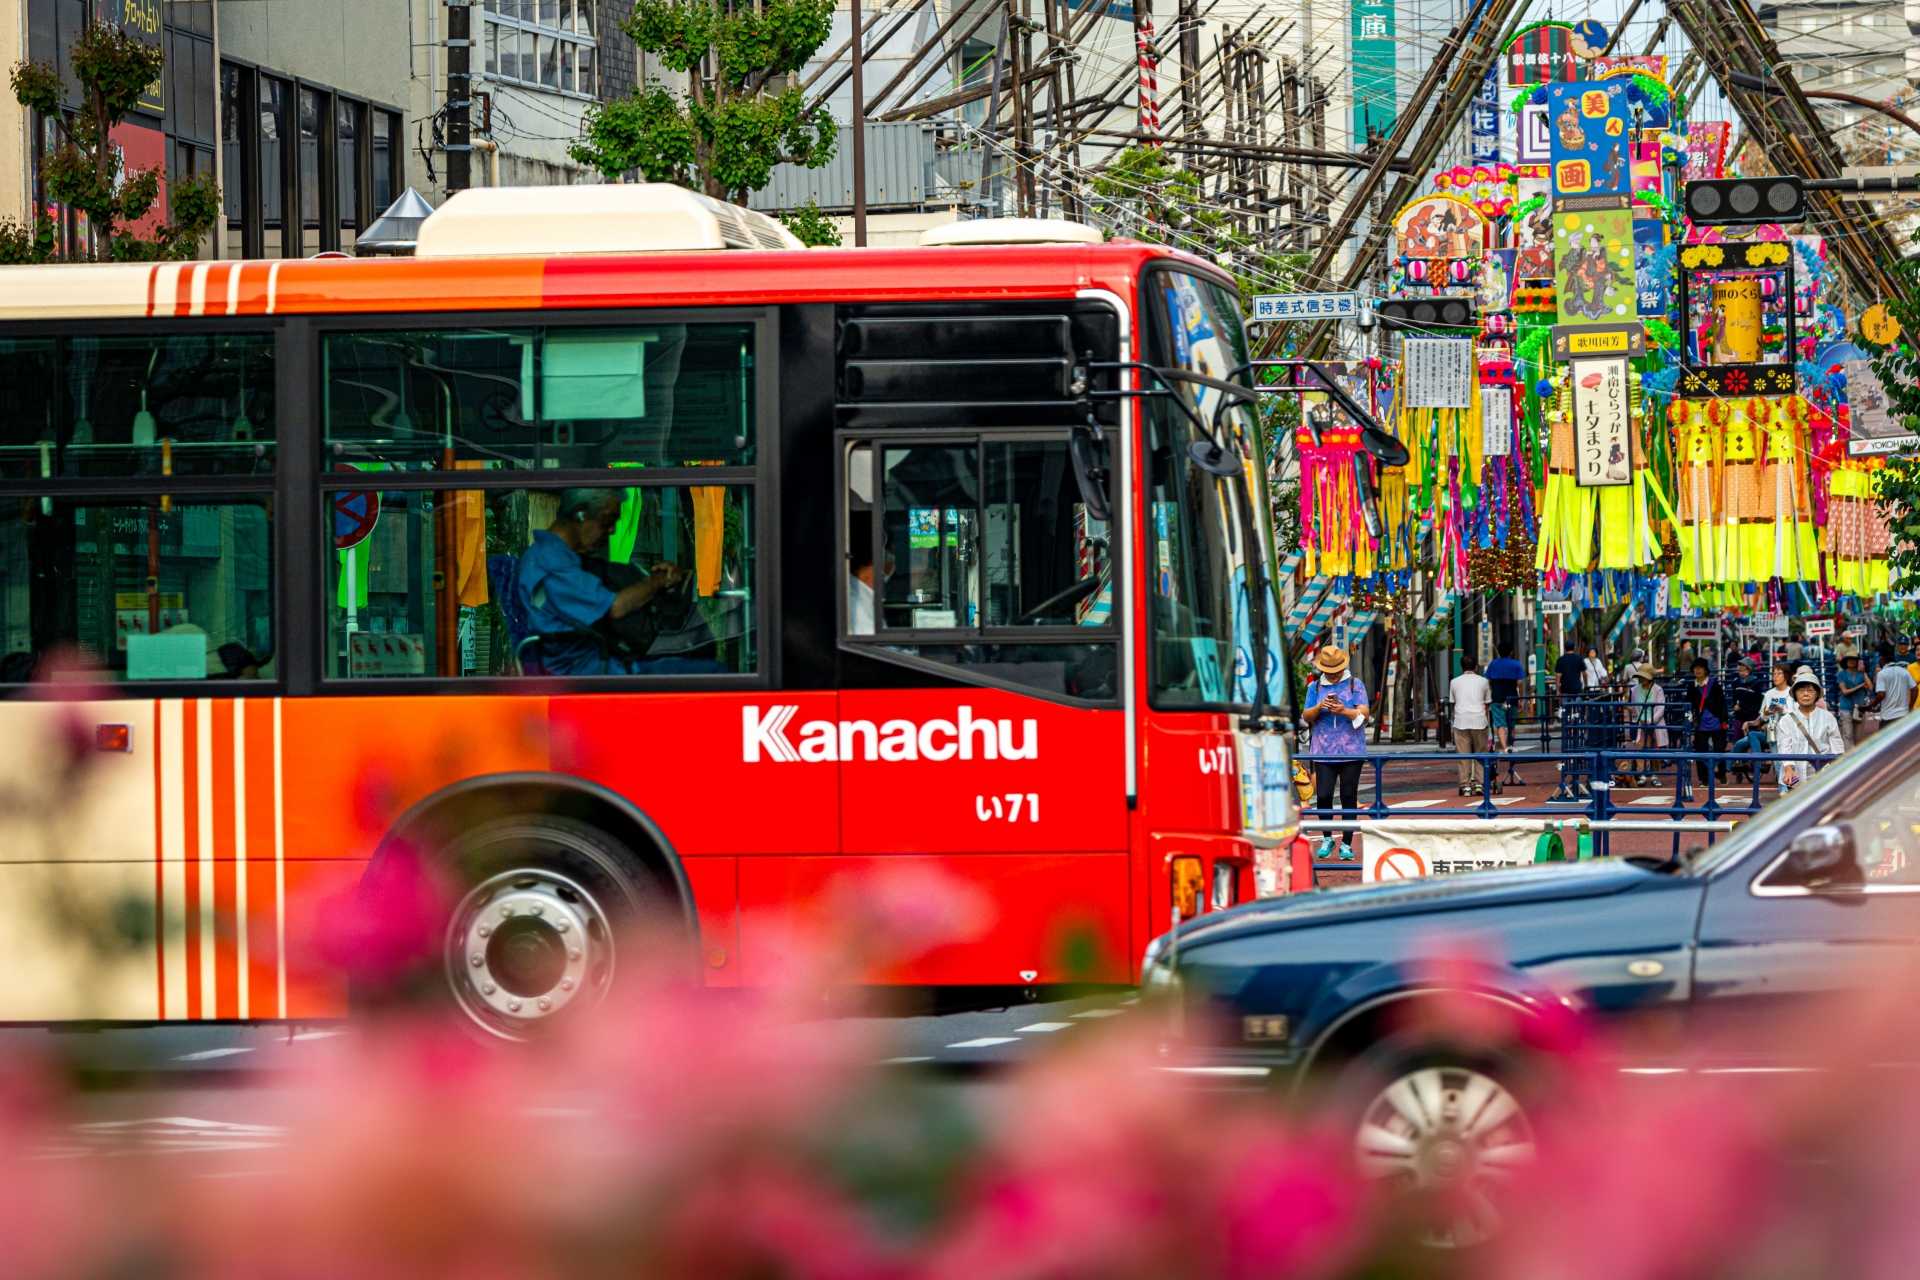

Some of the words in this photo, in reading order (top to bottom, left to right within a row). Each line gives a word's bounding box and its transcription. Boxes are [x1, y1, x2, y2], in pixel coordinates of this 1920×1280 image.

[1260, 298, 1352, 315] 時差式信号機
[1584, 400, 1602, 477] 七夕まつり
[742, 705, 1038, 762] Kanachu
[1199, 746, 1234, 775] い71
[975, 793, 1040, 823] い71
